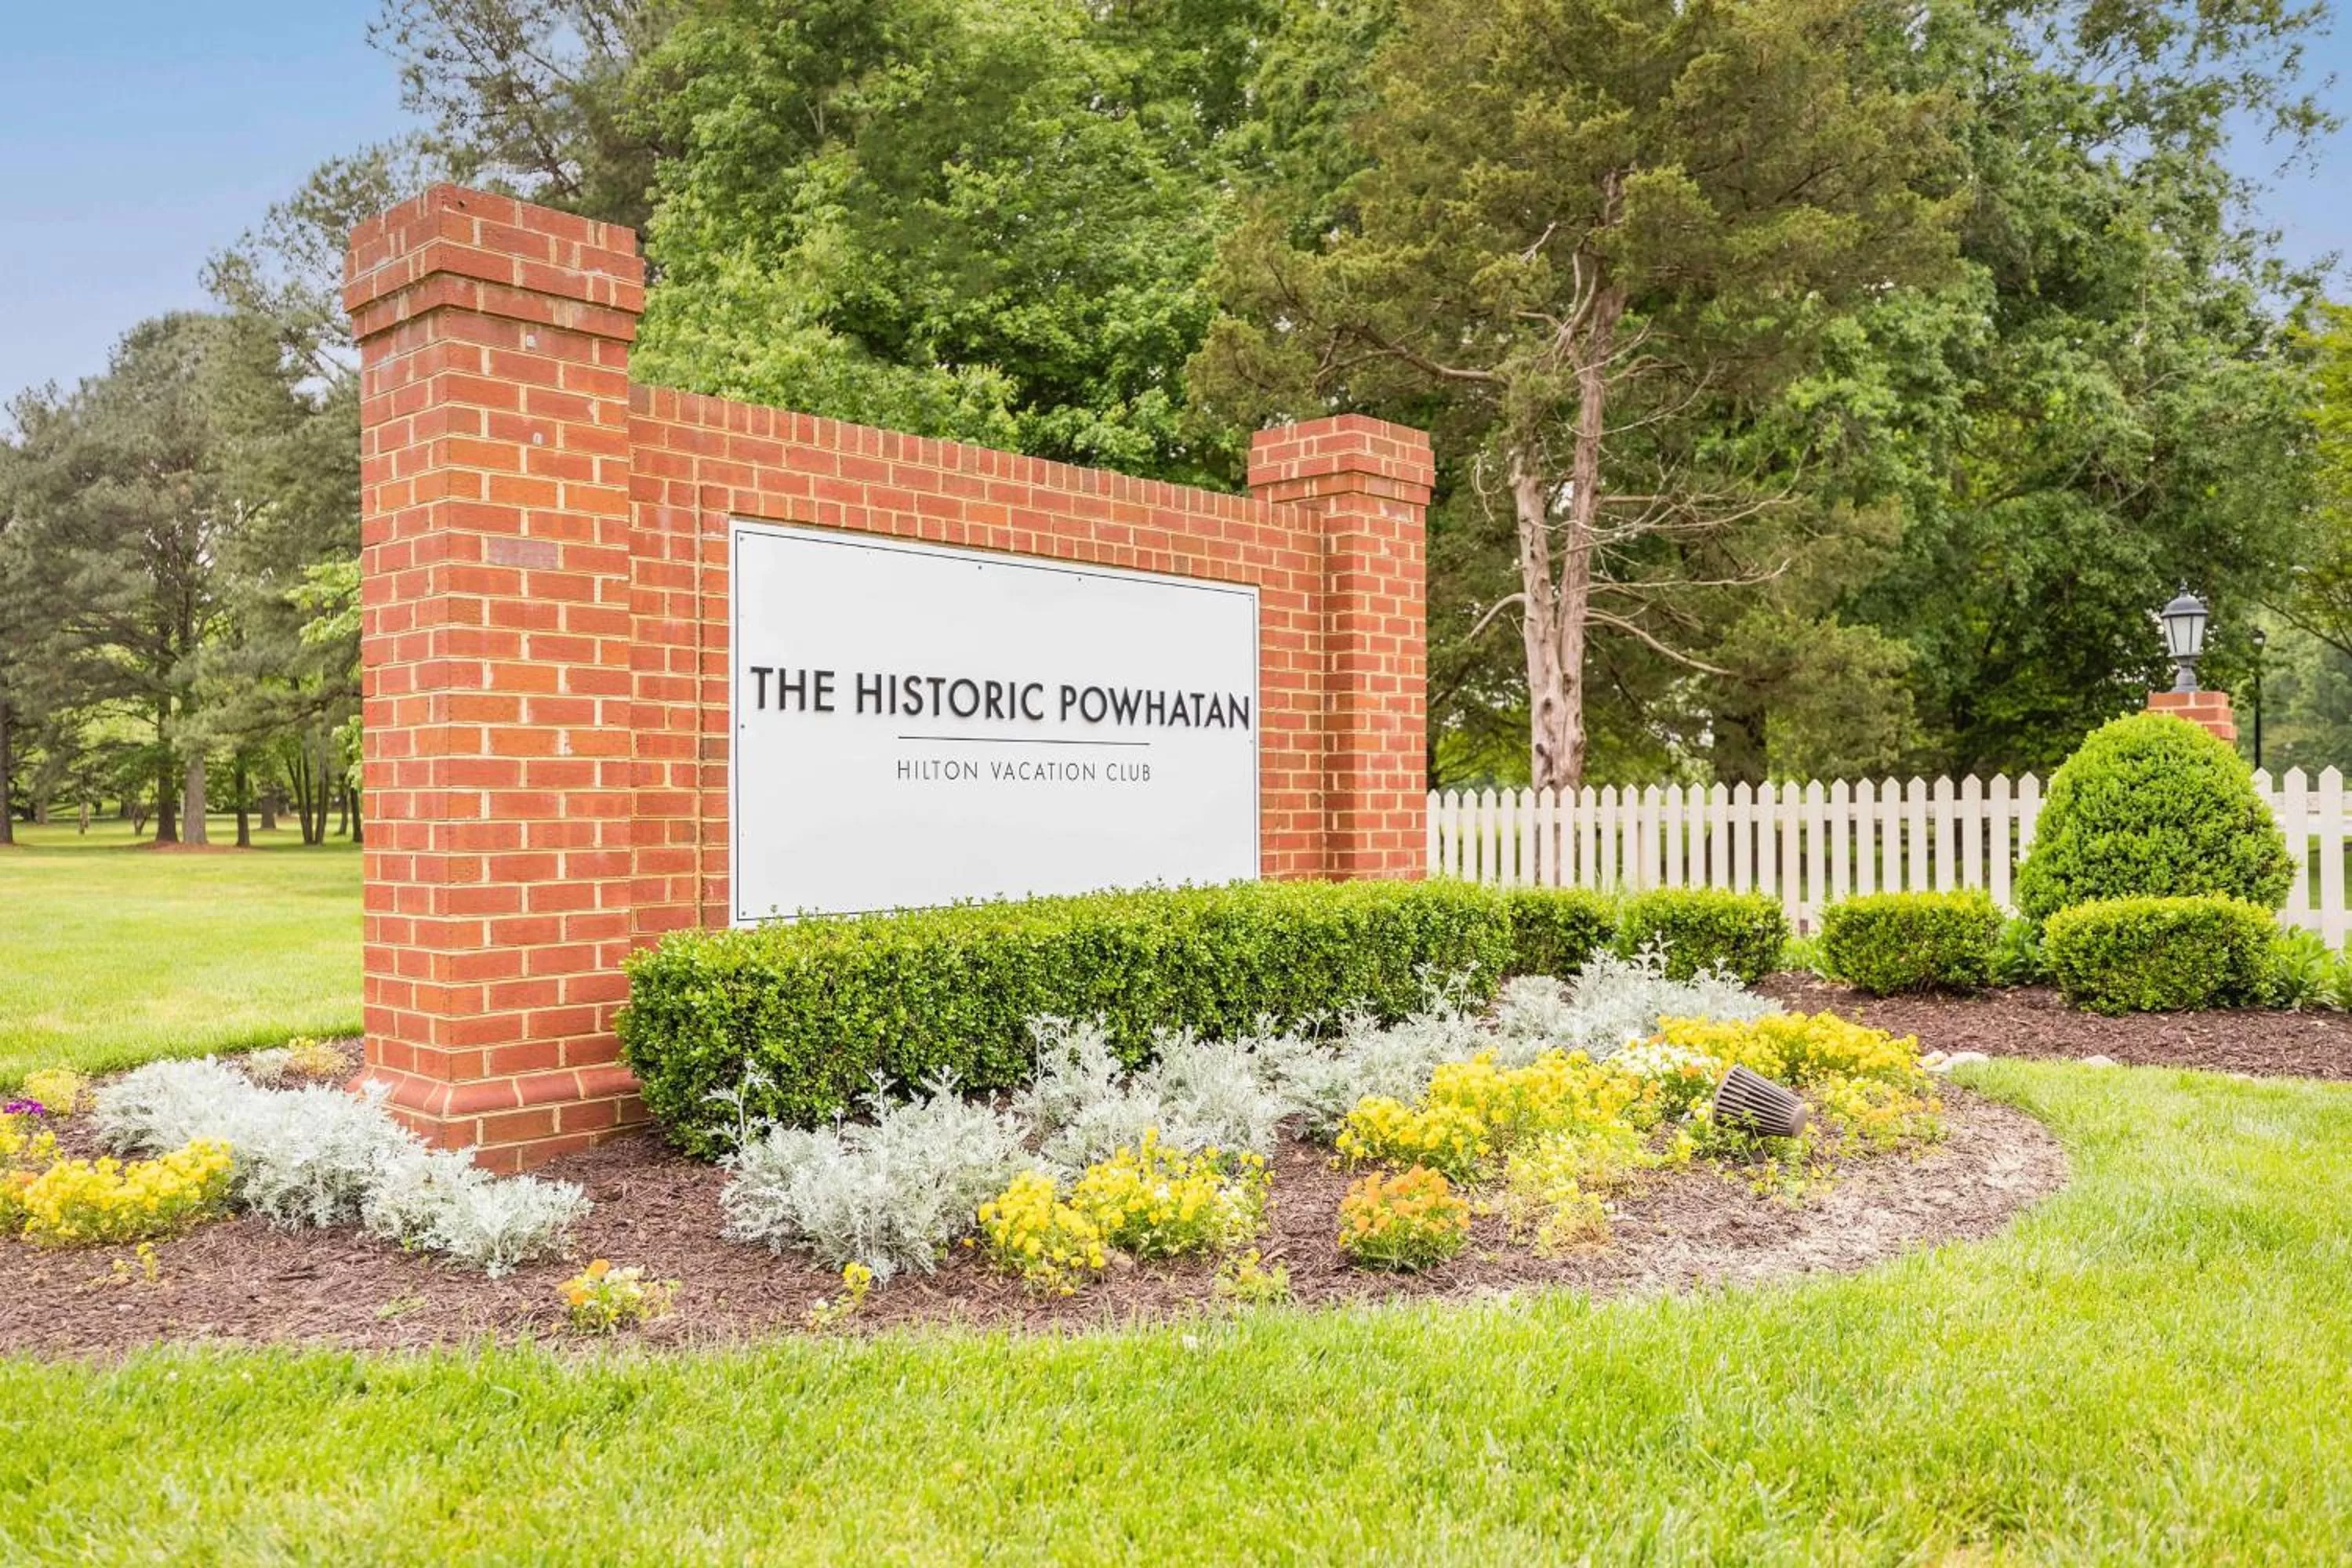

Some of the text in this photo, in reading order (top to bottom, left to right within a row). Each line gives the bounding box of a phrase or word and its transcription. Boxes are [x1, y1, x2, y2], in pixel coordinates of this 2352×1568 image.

[750, 666, 1249, 730] THE HISTORIC POWHATAN
[898, 760, 1149, 781] HILTON VACATION CLUB
